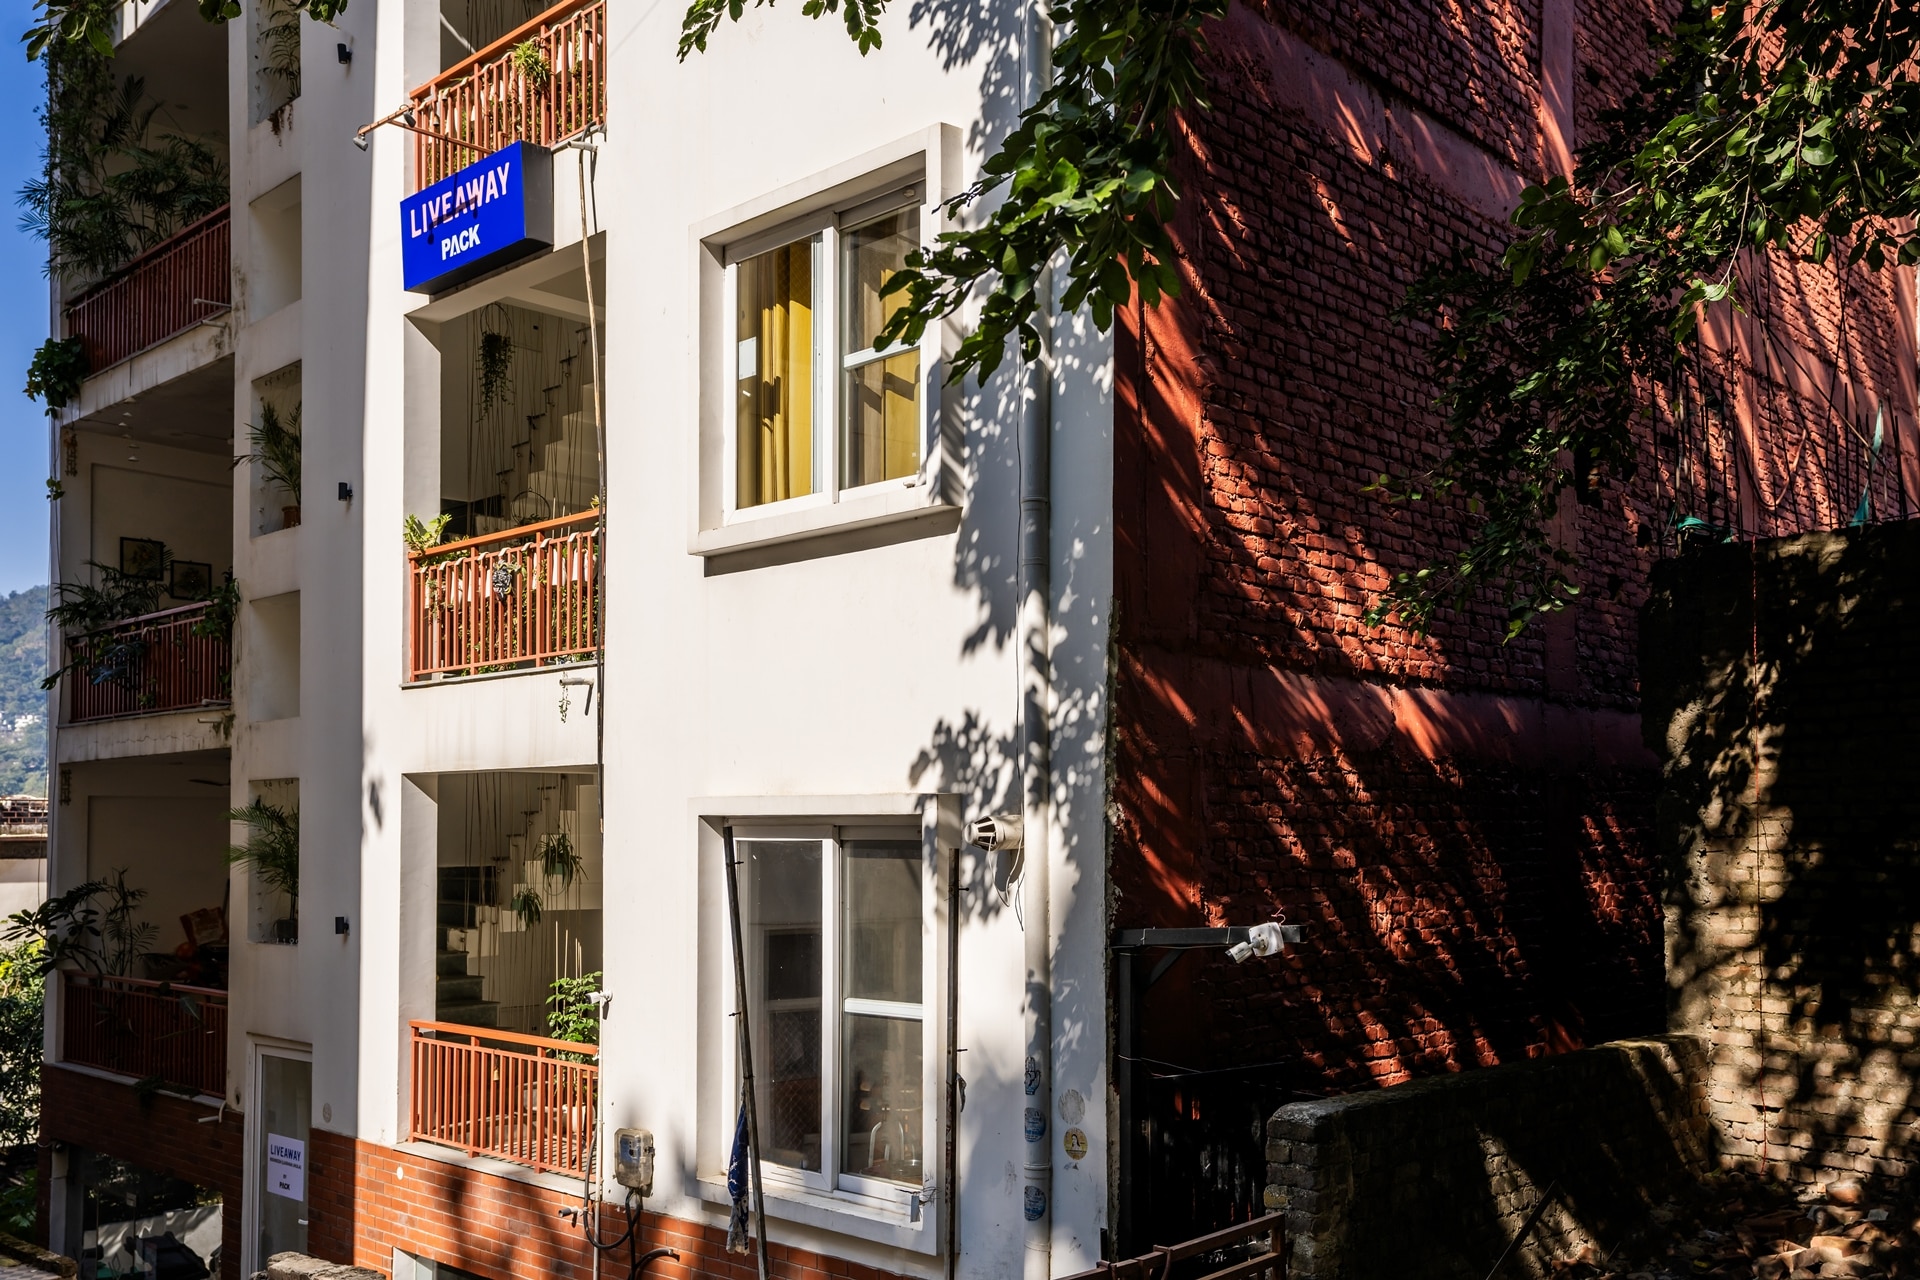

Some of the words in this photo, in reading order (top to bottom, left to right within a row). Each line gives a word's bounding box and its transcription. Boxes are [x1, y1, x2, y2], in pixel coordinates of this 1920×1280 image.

[410, 162, 510, 239] LIVEAWAY
[441, 223, 481, 261] PACK
[270, 1144, 302, 1161] LIVEAWAY
